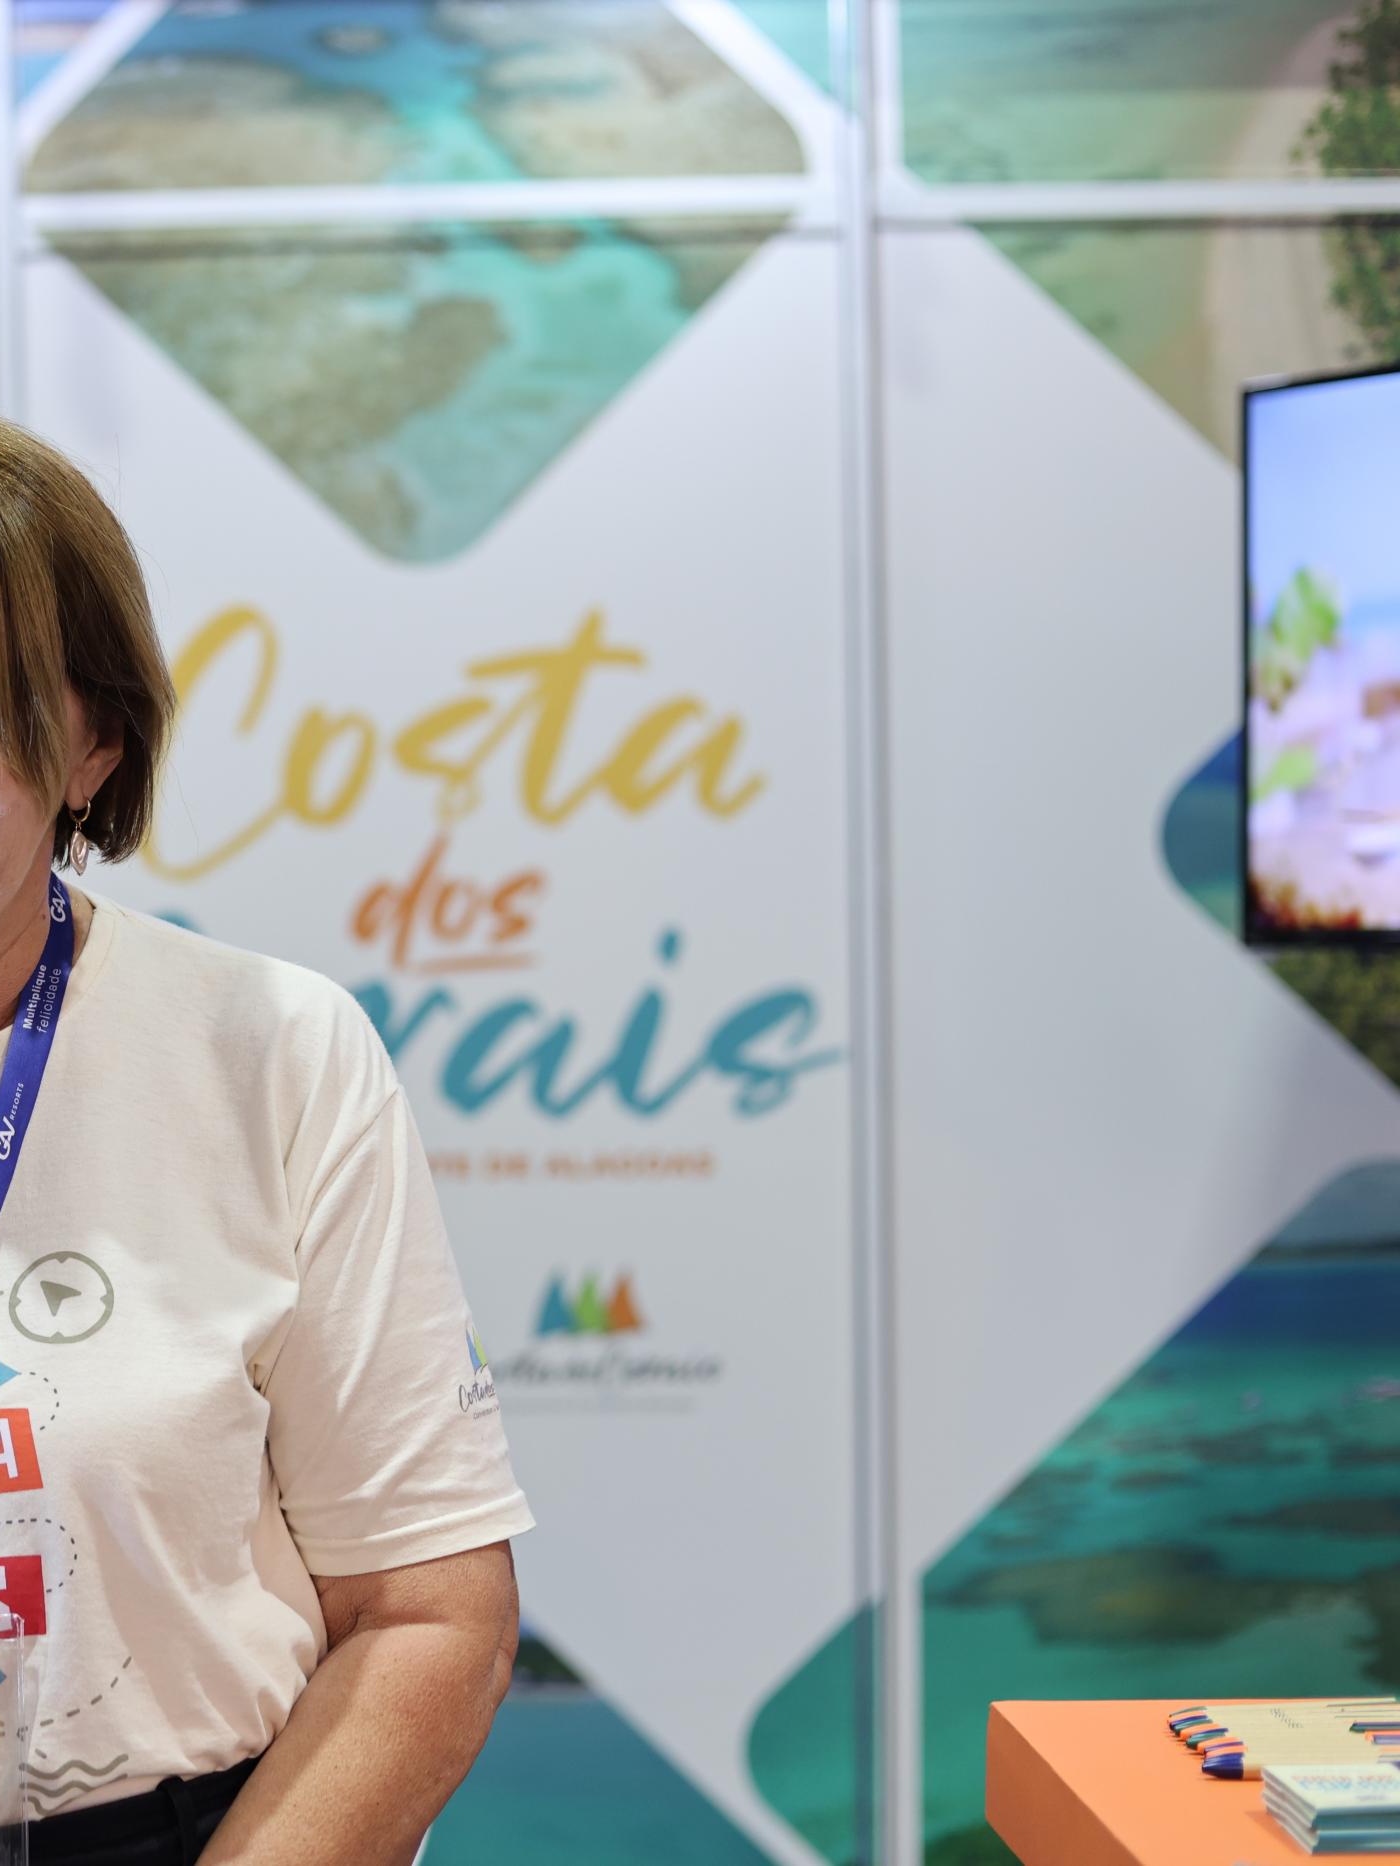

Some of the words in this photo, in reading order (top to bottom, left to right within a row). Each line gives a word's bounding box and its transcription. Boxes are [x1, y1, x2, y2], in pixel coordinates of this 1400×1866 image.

[141, 604, 768, 882] Costa
[348, 830, 548, 975] dos
[23, 964, 47, 1030] Multiplique
[37, 968, 62, 1033] felicidade
[9, 1082, 24, 1120] RESORTS
